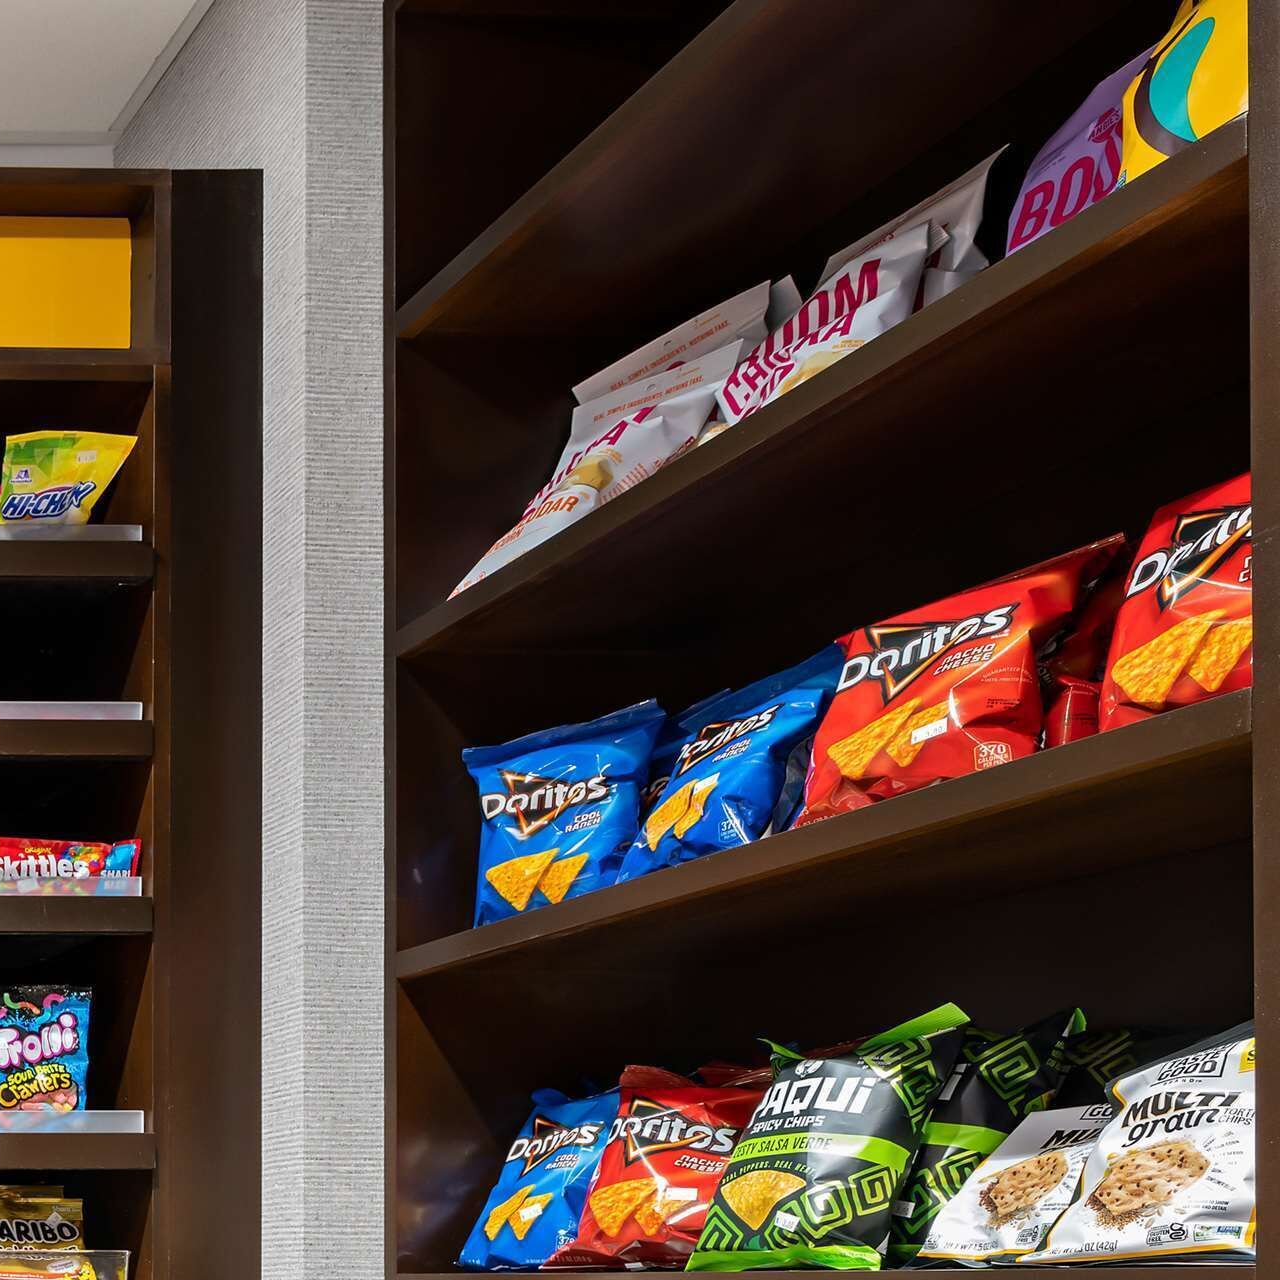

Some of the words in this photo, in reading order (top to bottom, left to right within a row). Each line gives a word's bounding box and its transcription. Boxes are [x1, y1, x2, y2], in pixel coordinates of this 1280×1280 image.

[836, 603, 1019, 693] Doritos
[941, 643, 996, 666] NACHO
[933, 652, 992, 676] CHEESE
[978, 744, 1007, 758] 370
[481, 776, 609, 822] Doritos
[1156, 1058, 1219, 1083] GOOD
[1164, 1049, 1225, 1073] TASTE
[1119, 1090, 1243, 1129] MULTI
[606, 1115, 738, 1154] Doritos
[750, 1118, 785, 1134] SPICY
[783, 1114, 825, 1130] CHIPS
[1124, 1106, 1220, 1149] grain
[505, 1122, 603, 1165] Doritos
[1146, 1228, 1171, 1240] GLUTEN
